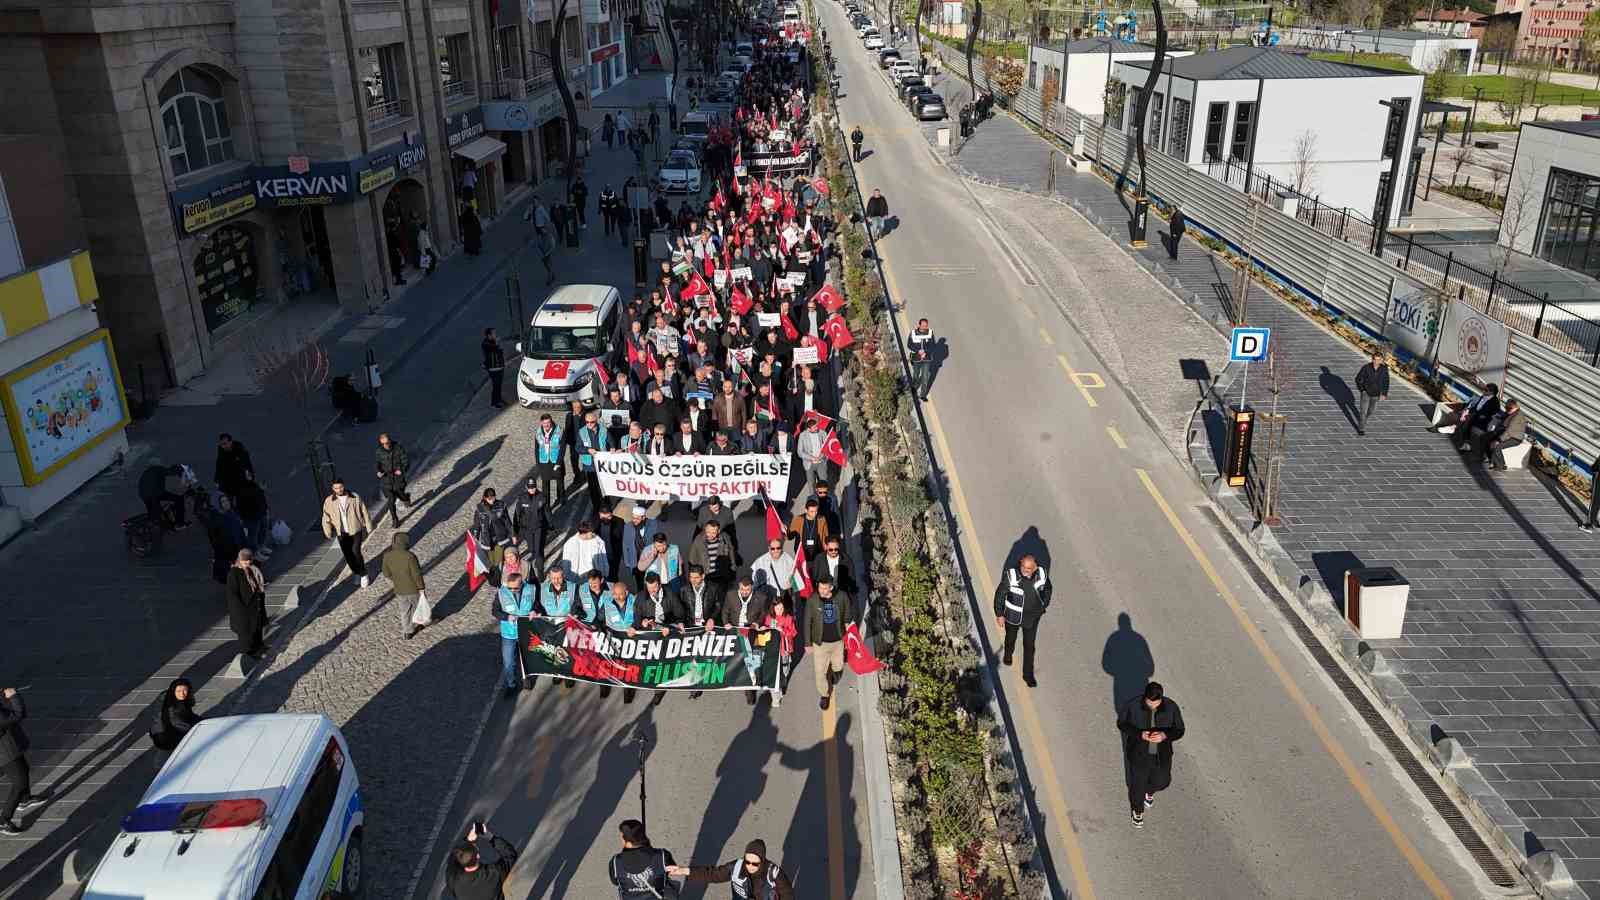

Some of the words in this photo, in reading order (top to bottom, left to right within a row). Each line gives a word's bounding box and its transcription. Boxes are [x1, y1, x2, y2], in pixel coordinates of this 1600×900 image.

[398, 144, 426, 169] KERVAN
[256, 175, 348, 198] KERVAN
[1241, 335, 1258, 354] D
[658, 460, 716, 477] ÖZGÜR
[721, 458, 789, 476] DEĞİLSE
[665, 631, 737, 659] DENİZE
